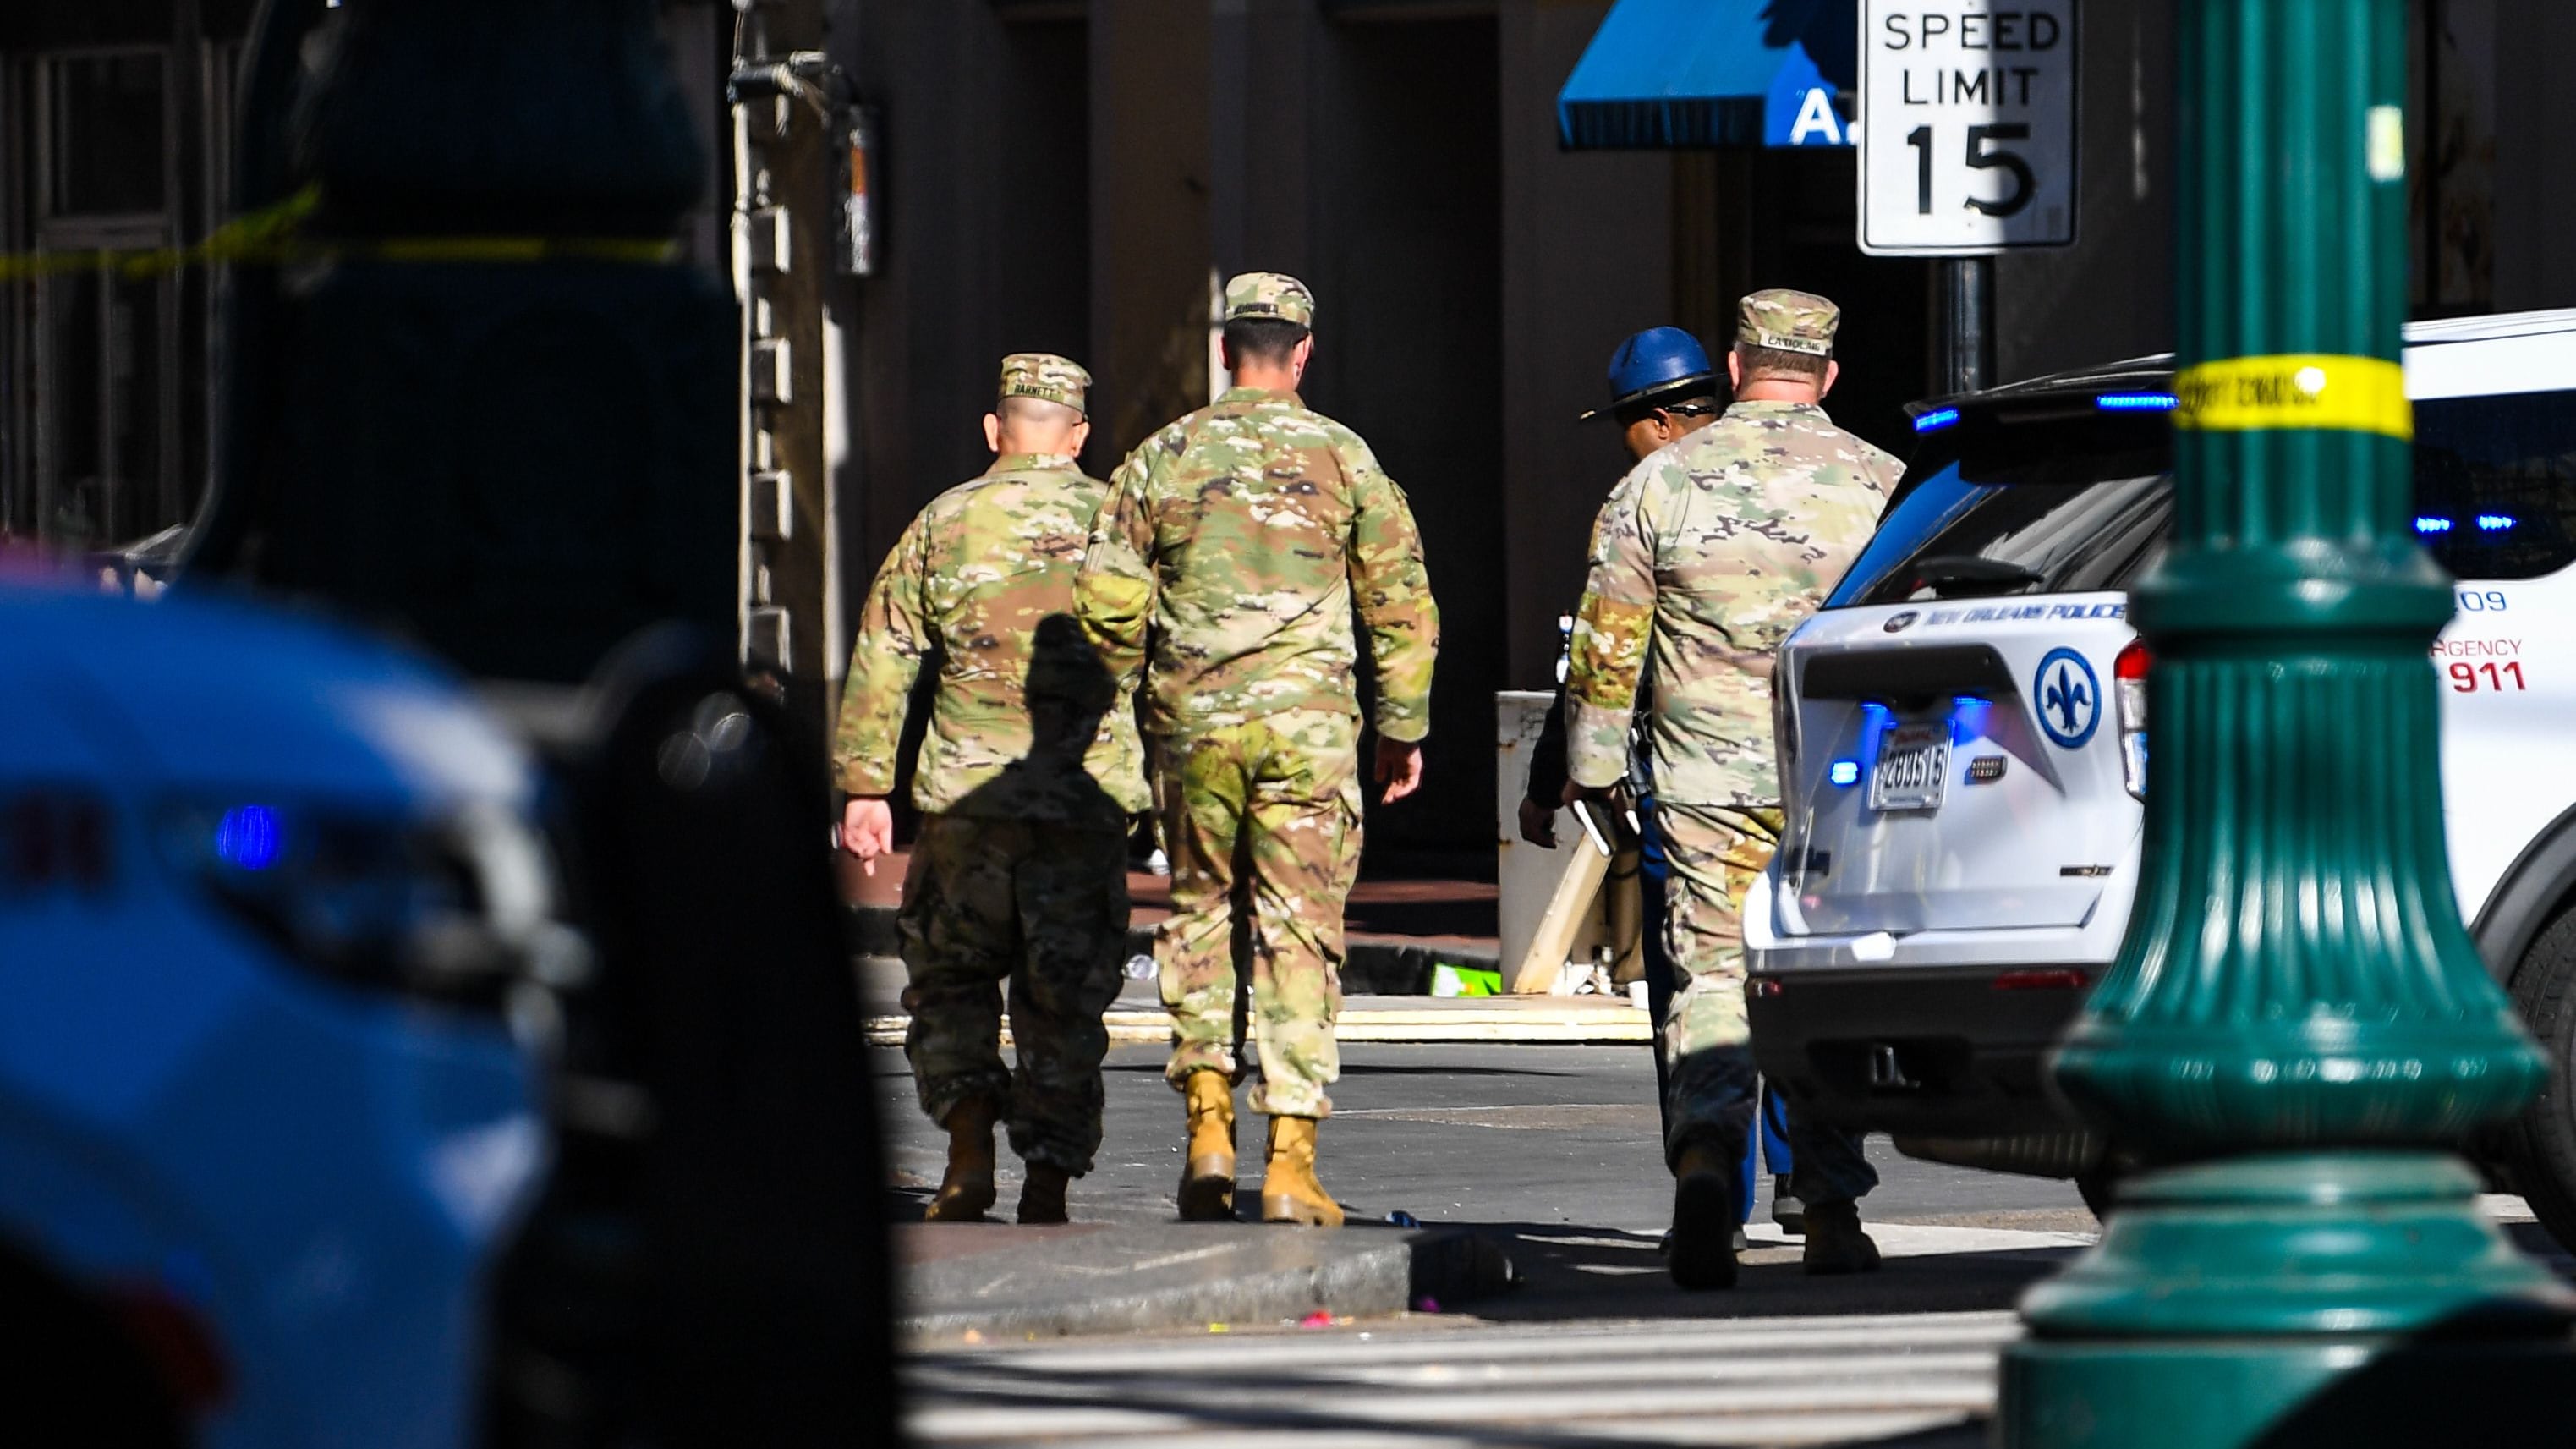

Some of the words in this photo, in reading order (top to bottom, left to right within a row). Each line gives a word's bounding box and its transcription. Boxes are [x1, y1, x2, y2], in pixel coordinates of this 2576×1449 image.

[1884, 13, 2061, 50] SPEED
[1903, 69, 2039, 105] LIMIT
[1906, 123, 2036, 218] 15
[1014, 383, 1055, 398] BARNETT
[1962, 605, 2047, 623] ORLEANS
[2046, 602, 2126, 619] POLICE
[2449, 661, 2526, 693] 911
